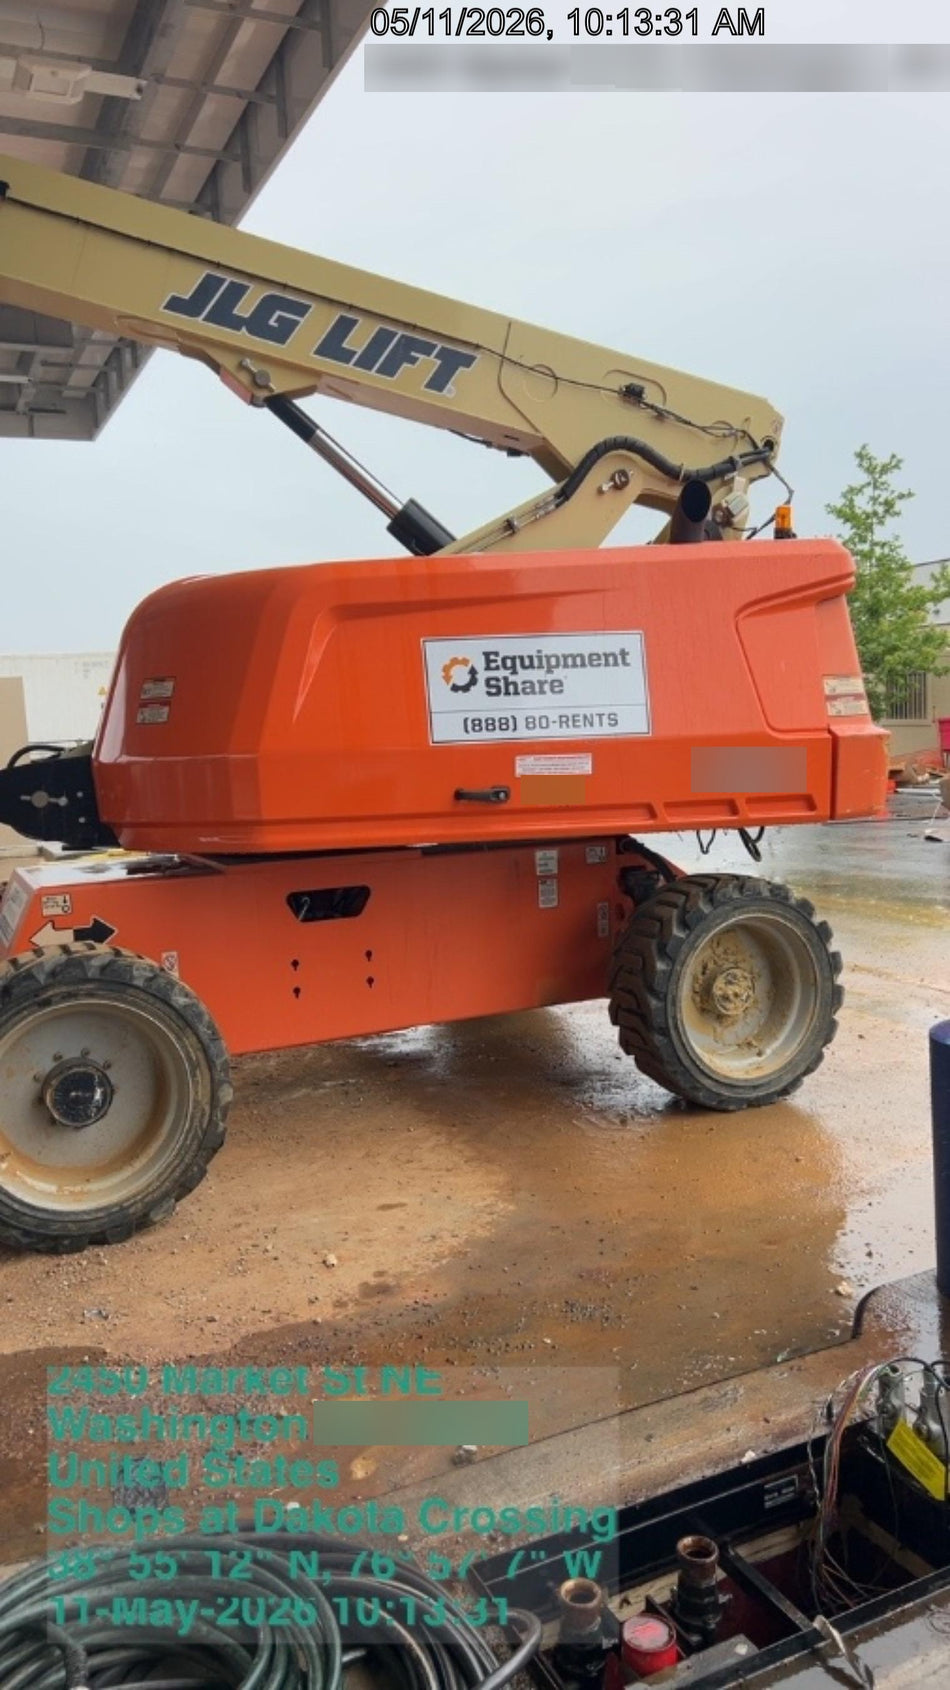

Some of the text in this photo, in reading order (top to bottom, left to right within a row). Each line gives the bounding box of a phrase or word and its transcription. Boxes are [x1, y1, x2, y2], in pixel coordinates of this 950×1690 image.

[161, 270, 478, 394] JLG LIFT
[482, 648, 631, 676] Equipment
[484, 676, 565, 697] Share
[463, 714, 518, 734] (888)
